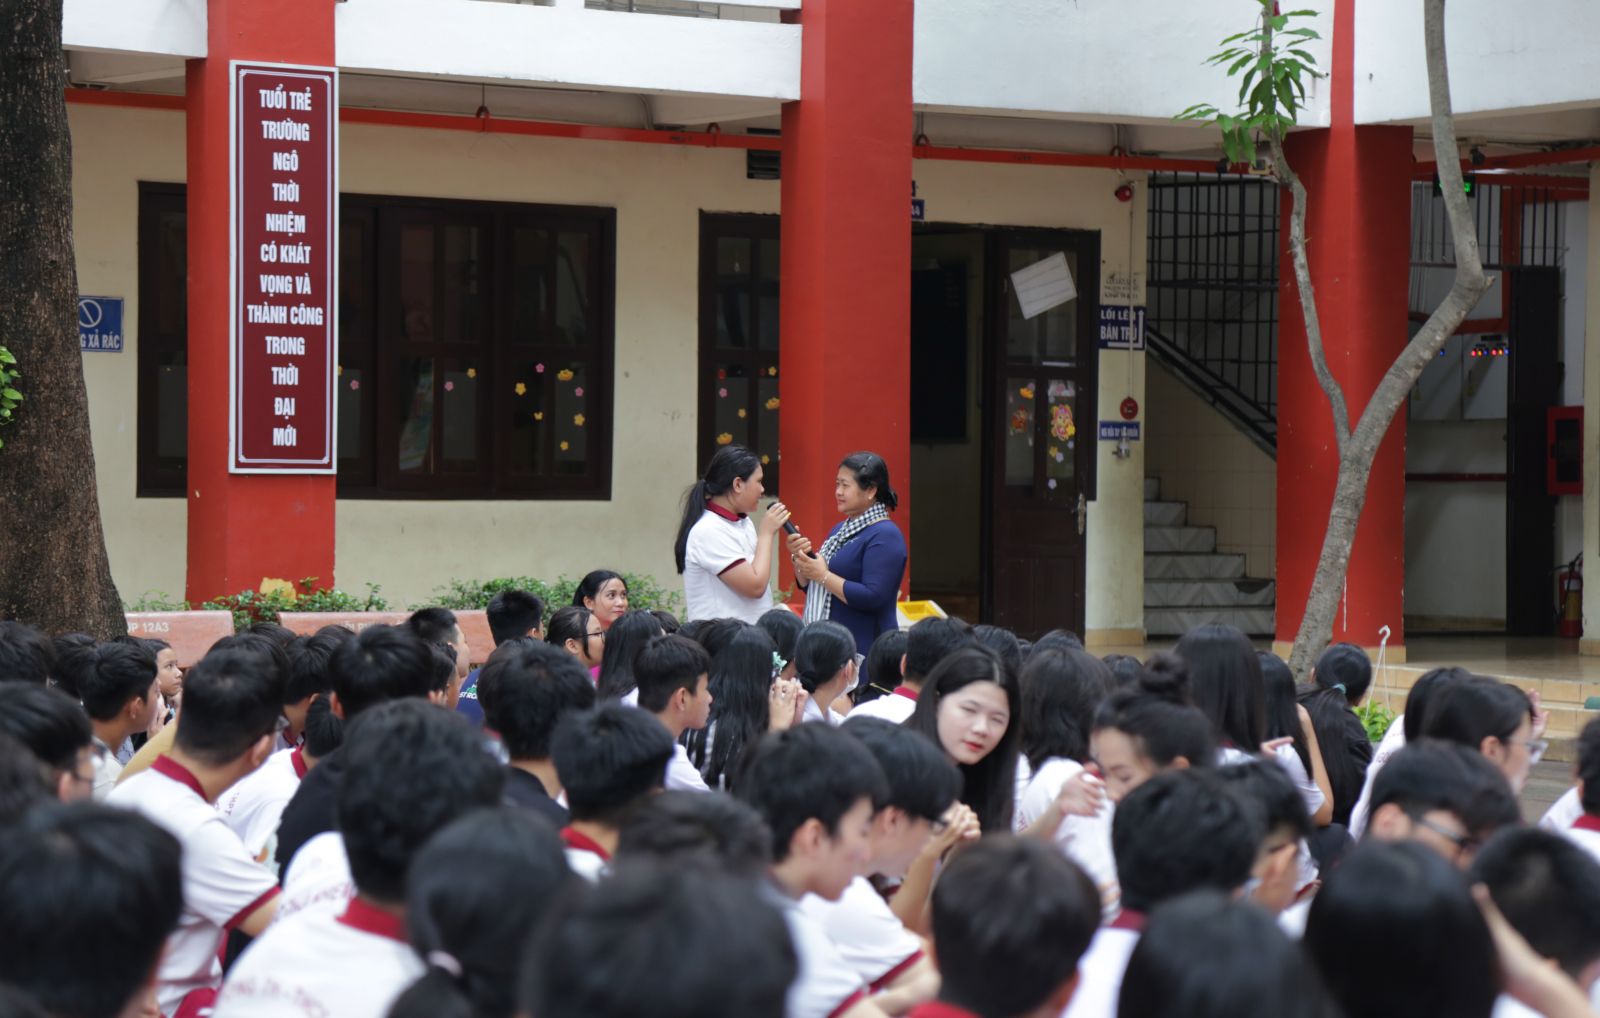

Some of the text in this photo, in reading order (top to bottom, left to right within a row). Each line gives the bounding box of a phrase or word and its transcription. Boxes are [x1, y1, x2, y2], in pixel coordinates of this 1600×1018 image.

[259, 84, 312, 111] TUỔI TRẺ
[261, 118, 310, 141] TRƯỜNG
[273, 150, 299, 172] NGÔ
[271, 179, 300, 203] THỜI
[265, 211, 306, 237] NHIỆM
[260, 241, 311, 265] CÓ KHÁT
[259, 273, 312, 298] VỌNG VÀ
[246, 302, 324, 326] THÀNH CÔNG
[1100, 307, 1116, 320] LỐI
[88, 329, 99, 348] XẢ
[102, 331, 120, 348] RÁC
[1100, 323, 1119, 340] BÁN
[264, 336, 306, 356] TRONG
[271, 363, 299, 386] THỜI
[274, 397, 296, 420] ĐẠI
[273, 424, 297, 447] MỚI
[143, 622, 169, 632] 12A3
